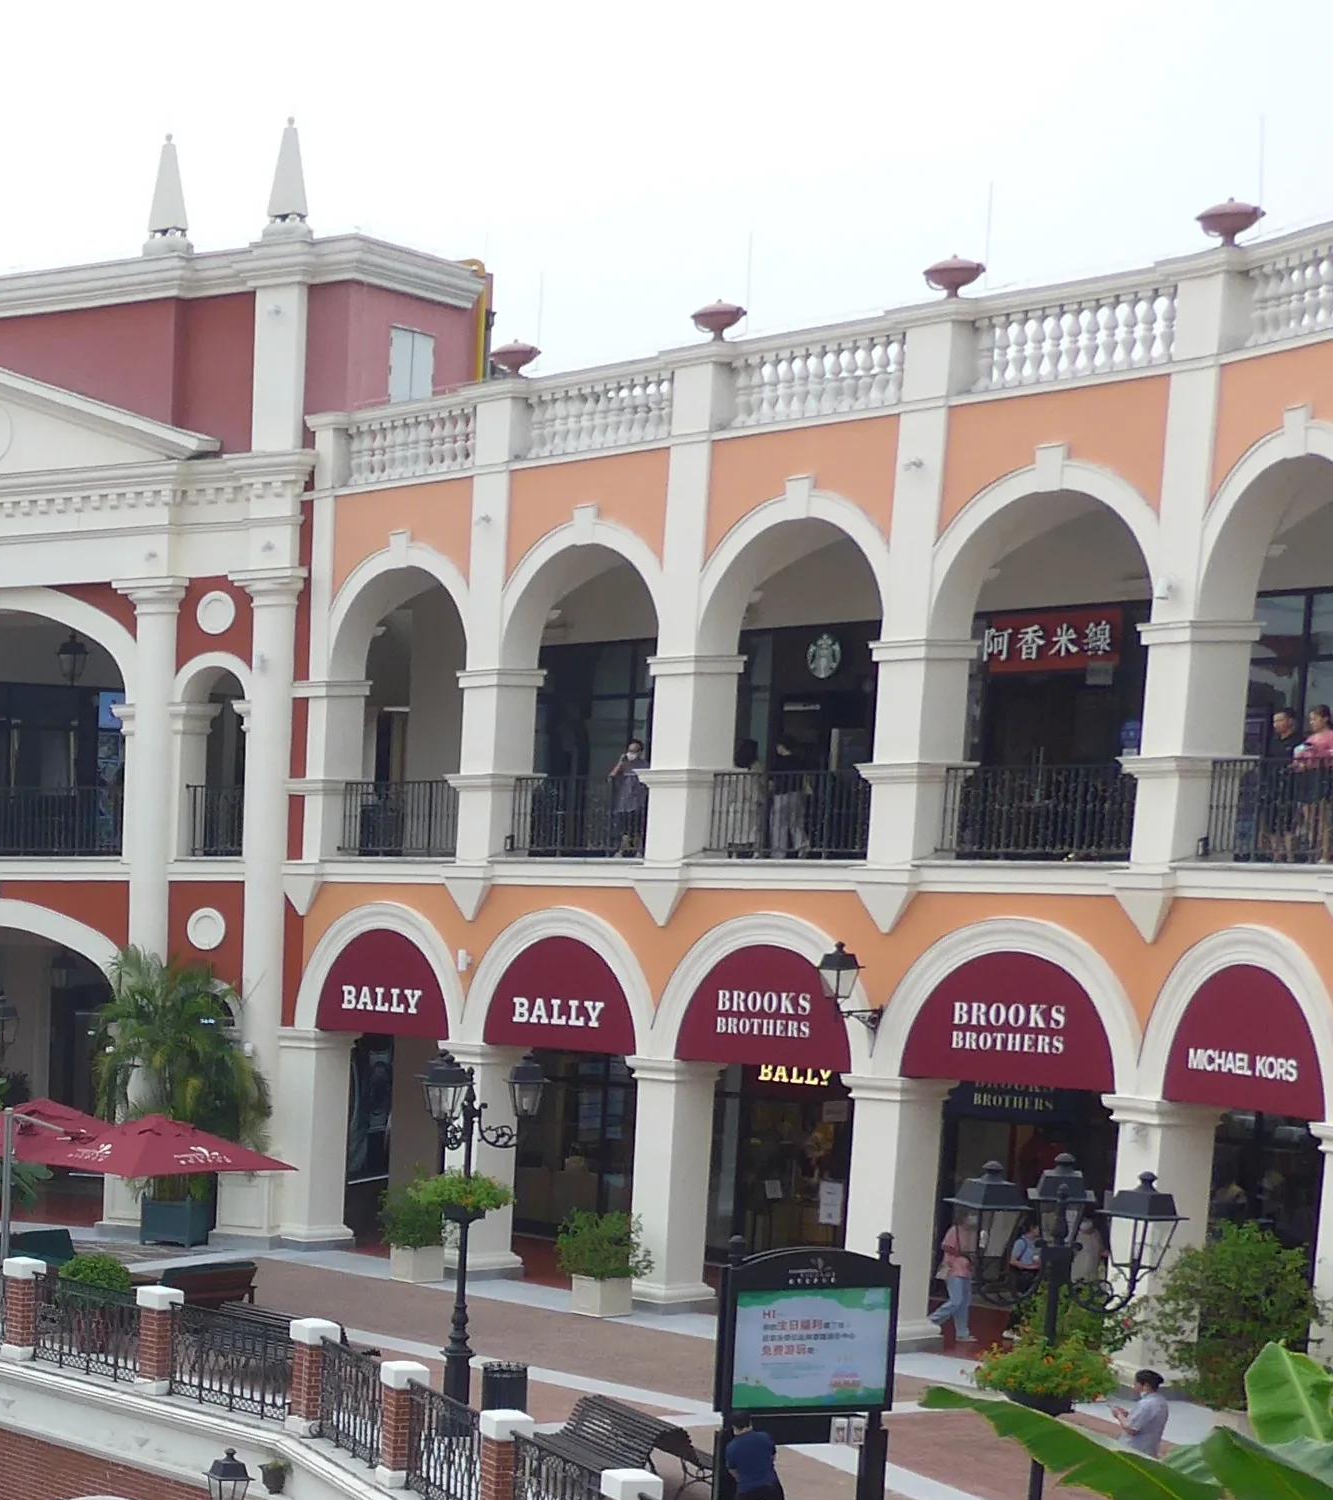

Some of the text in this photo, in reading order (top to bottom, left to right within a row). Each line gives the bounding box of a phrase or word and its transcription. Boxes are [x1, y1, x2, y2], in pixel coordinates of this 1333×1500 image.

[983, 620, 1111, 662] 阿香米線
[342, 984, 422, 1014] BALLY
[512, 996, 605, 1028] BALLY
[717, 989, 811, 1016] BROOKS
[716, 1016, 810, 1039] BROTHERS
[952, 1001, 1066, 1030] BROOKS
[951, 1030, 1064, 1055] BROTHERS
[758, 1064, 832, 1086] BALLY
[1188, 1048, 1298, 1082] MICHAEL KORS
